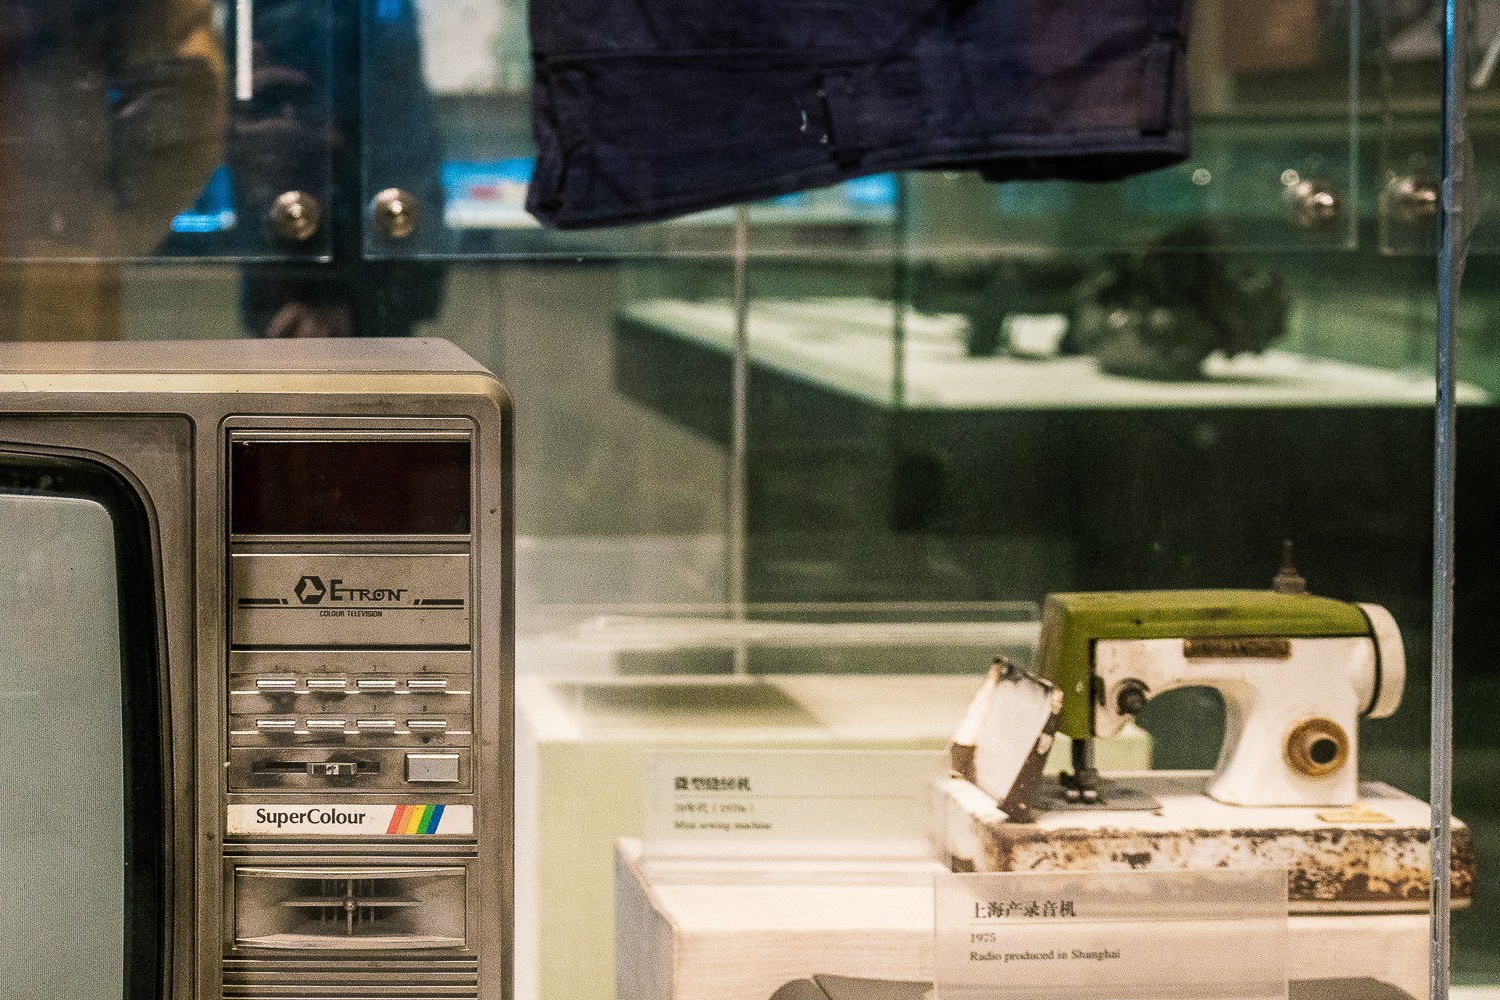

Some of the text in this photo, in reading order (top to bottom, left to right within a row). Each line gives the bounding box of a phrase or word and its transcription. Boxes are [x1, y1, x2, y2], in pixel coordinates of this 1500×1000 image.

[256, 808, 366, 828] SuperColour
[975, 900, 1077, 918] 上海产录音机
[970, 932, 997, 943] 1975
[969, 949, 1121, 963] Radio produced in Shanghai
